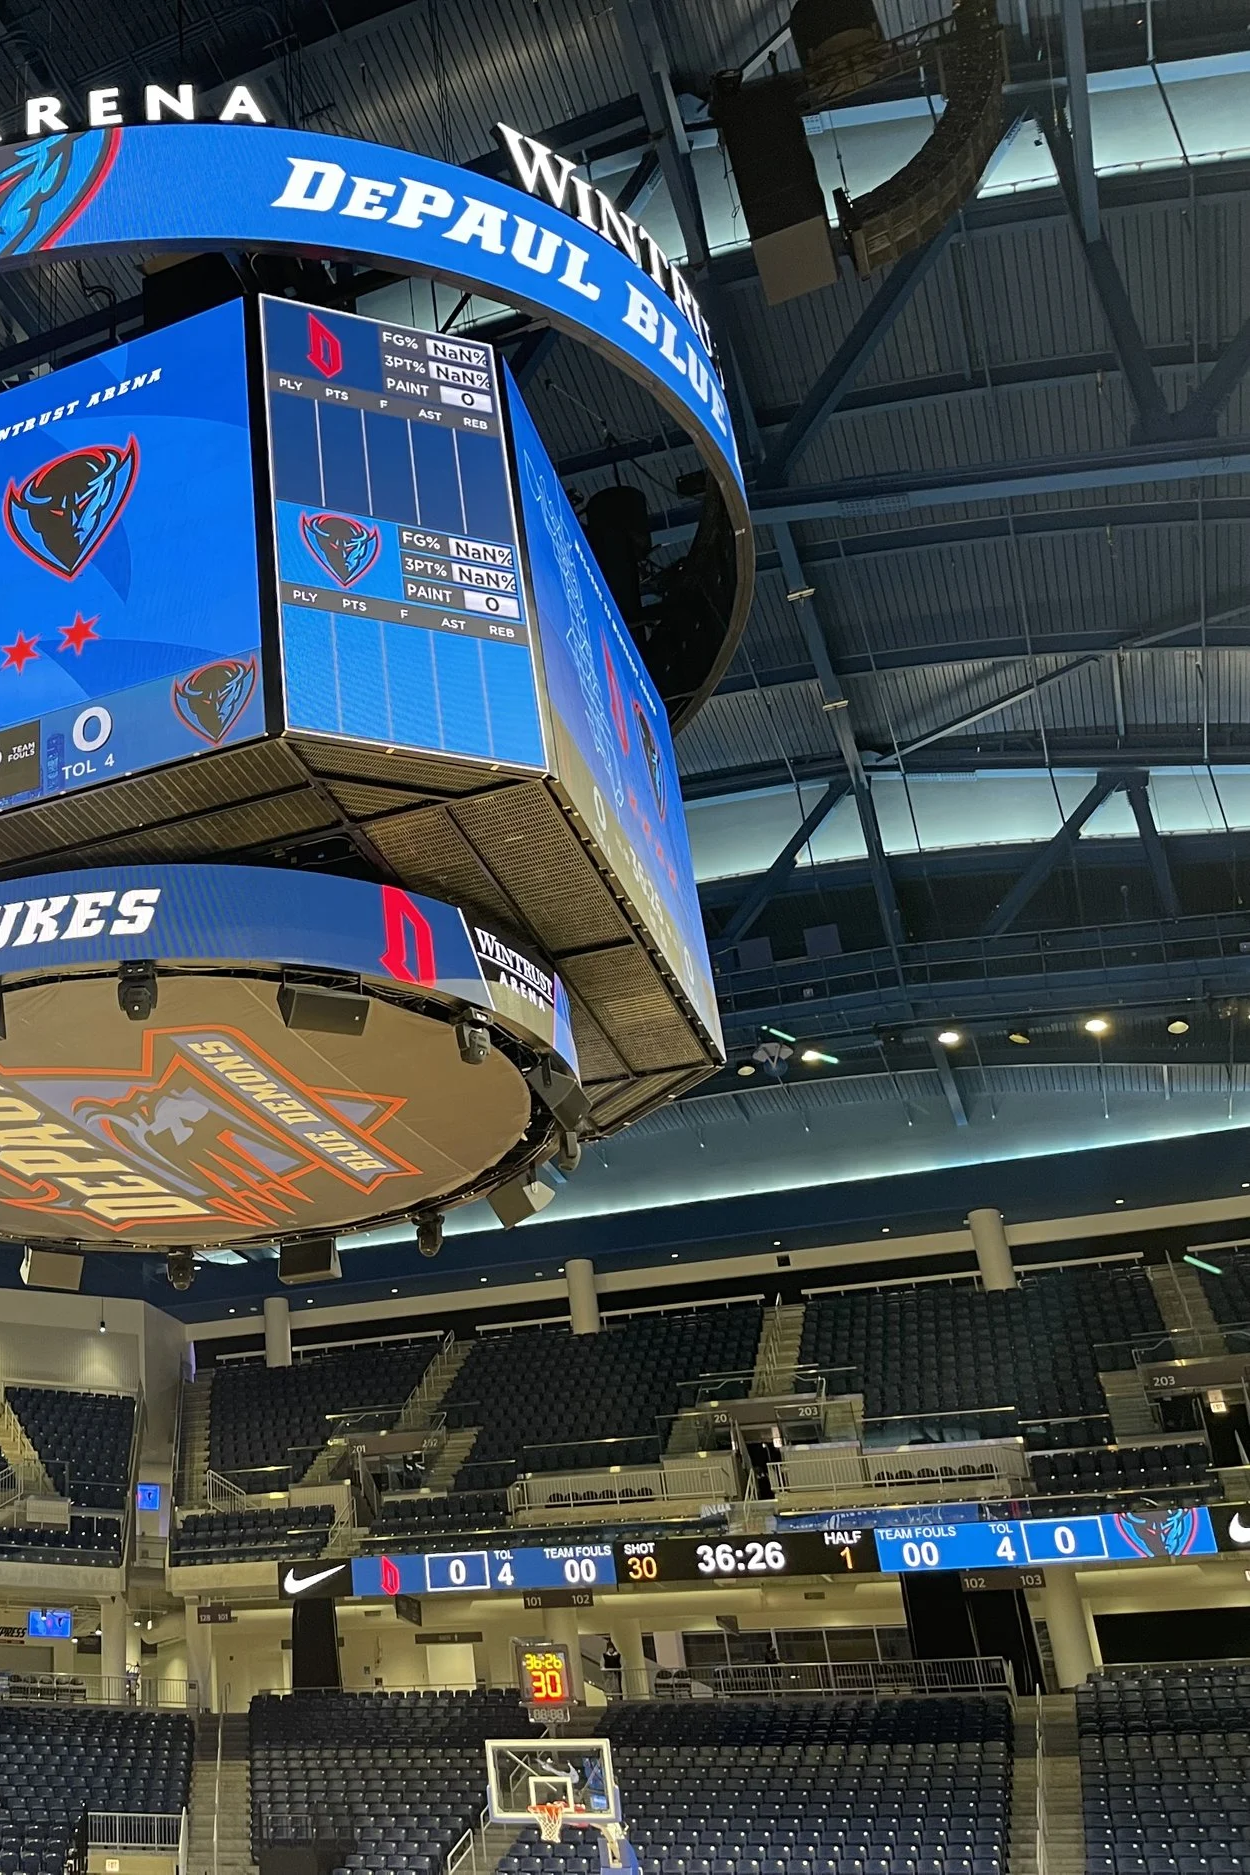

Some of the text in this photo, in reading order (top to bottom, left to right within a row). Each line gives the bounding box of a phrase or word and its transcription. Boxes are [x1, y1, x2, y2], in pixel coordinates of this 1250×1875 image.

[382, 332, 489, 367] FG% NaN%
[622, 280, 728, 436] BLUE
[384, 355, 491, 390] 3PT% NaN%
[86, 367, 163, 409] ARENA
[387, 378, 429, 397] PAINT
[279, 378, 488, 430] PLY PTS F AST REB
[402, 531, 514, 567] FG% NaN%
[405, 557, 518, 592] 3PT% NaN%
[407, 583, 452, 602] PAINT
[293, 589, 515, 638] PLY PTS F AST REB
[71, 706, 111, 751] 0
[7, 748, 36, 763] FOULS
[11, 741, 36, 755] TEAM
[62, 753, 115, 781] TOL 4
[474, 926, 554, 998] WINTRUST
[499, 971, 546, 1013] ARENA
[187, 1040, 388, 1171] BLUE DEMONS
[1153, 1375, 1176, 1387] 203
[798, 1406, 819, 1417] 203
[824, 1531, 862, 1545] HALF
[878, 1524, 1013, 1540] TEAM FOULS TOL
[494, 1545, 612, 1560] TOL TEAM FOULS
[623, 1542, 655, 1555] SHOT
[696, 1541, 786, 1573] 36:26
[840, 1546, 854, 1570] 1
[902, 1525, 1076, 1568] 00 4 0
[449, 1559, 466, 1585] 0
[497, 1559, 596, 1585] 4 00
[627, 1556, 658, 1580] 30
[964, 1573, 1042, 1591] 102 103
[525, 1594, 591, 1607] 101 102
[199, 1613, 229, 1622] 128 101
[525, 1653, 563, 1670] 36:26
[531, 1671, 562, 1697] 30
